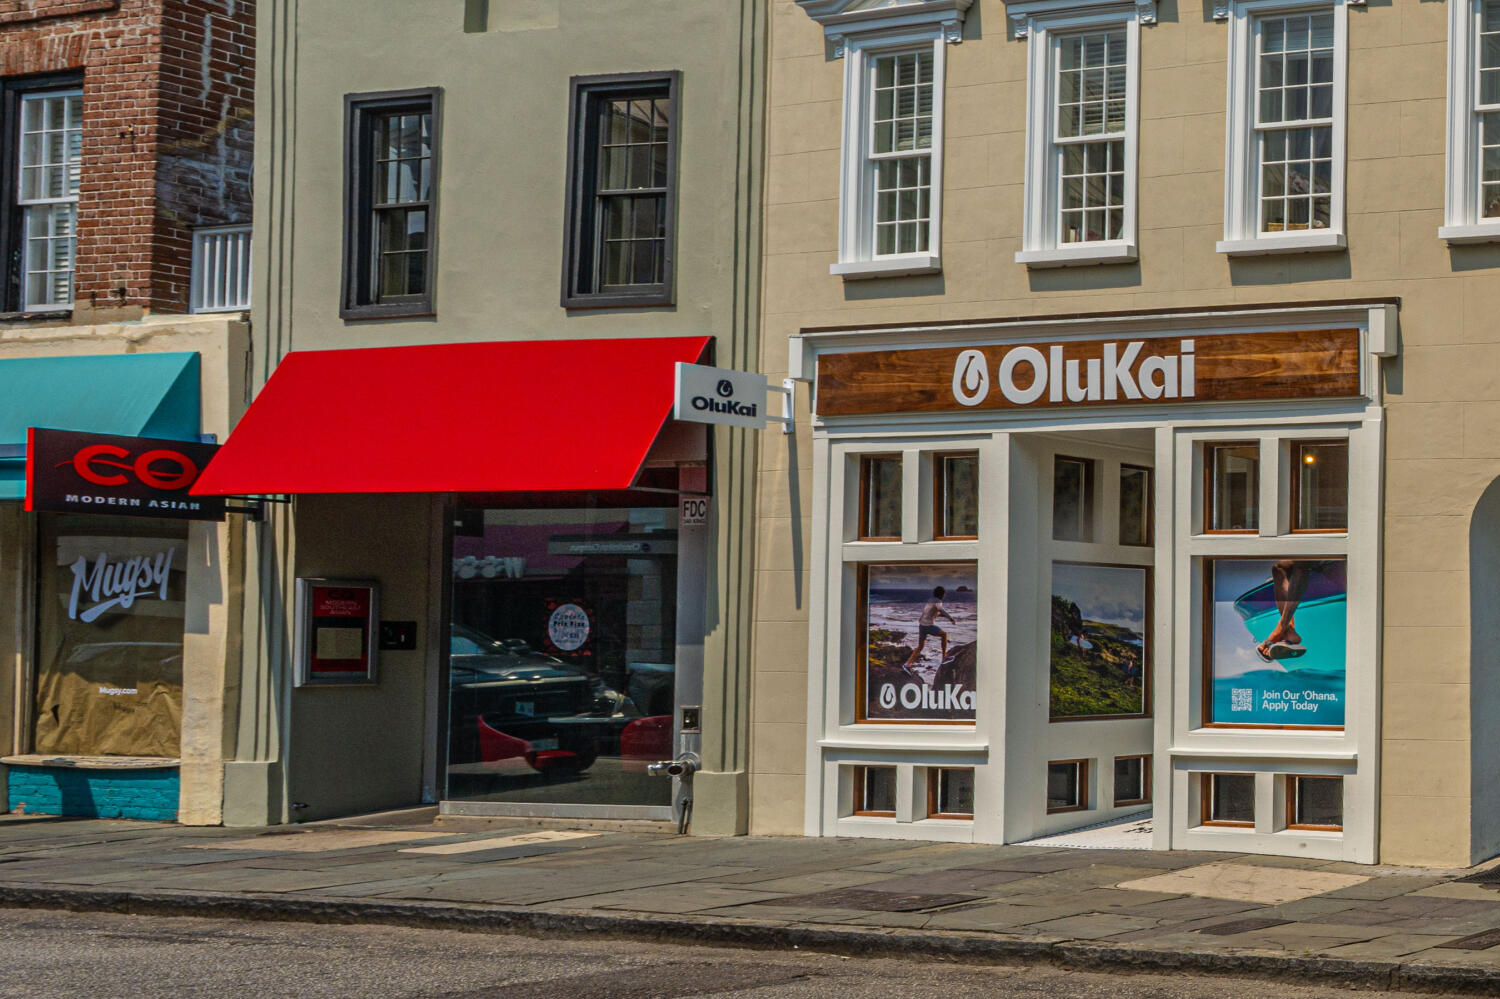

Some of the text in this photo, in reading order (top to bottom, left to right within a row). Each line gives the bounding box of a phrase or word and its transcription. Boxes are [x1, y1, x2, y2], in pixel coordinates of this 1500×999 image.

[998, 339, 1195, 405] OluKai
[691, 396, 757, 417] OluKai
[73, 444, 198, 490] CO
[65, 494, 200, 510] MODERN ASIAN
[683, 500, 706, 518] FDC
[69, 547, 175, 623] Mugsy
[1262, 690, 1280, 700] Join
[1282, 690, 1300, 700] Our
[1262, 700, 1319, 712] Apply Today
